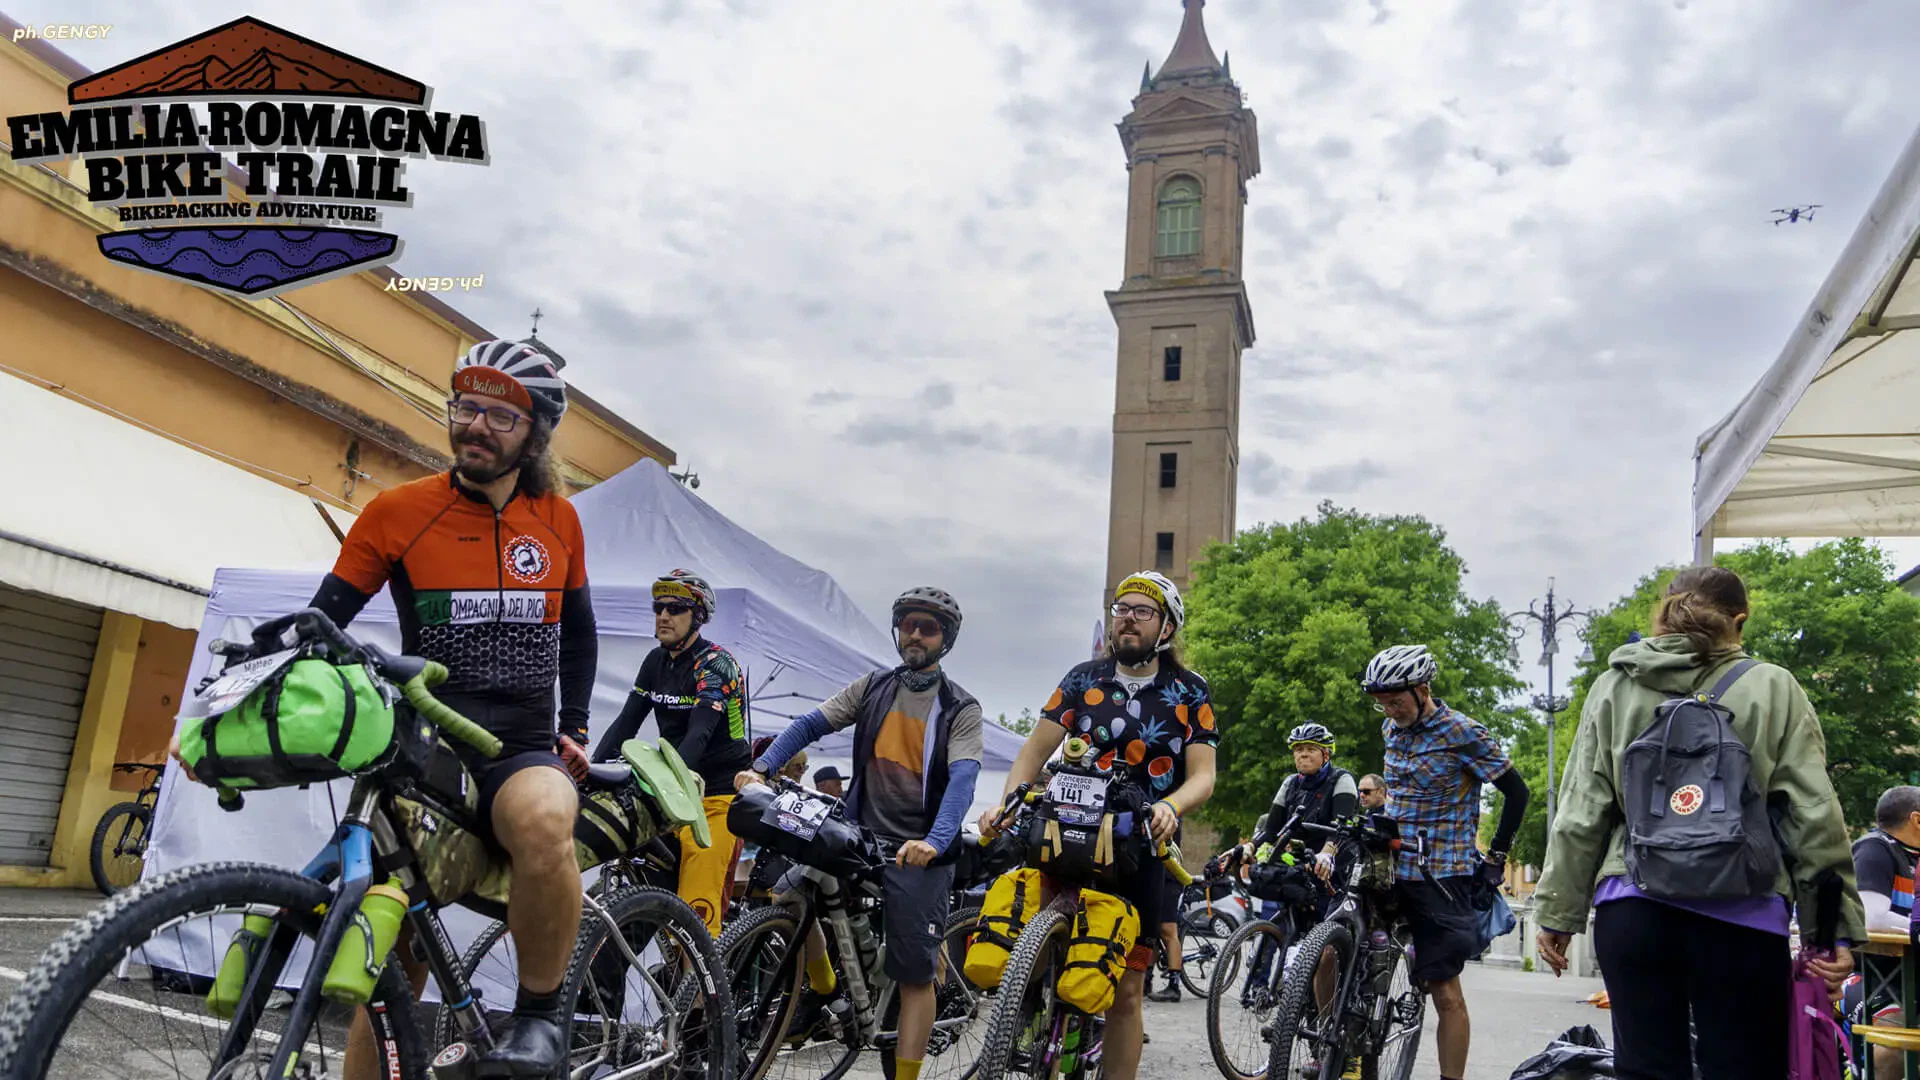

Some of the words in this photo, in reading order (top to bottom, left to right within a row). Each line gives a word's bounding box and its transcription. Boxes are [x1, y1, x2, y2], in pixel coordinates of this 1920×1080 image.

[443, 598, 505, 620] COMPAGNIA
[507, 597, 525, 619] DEL
[1061, 787, 1083, 803] 141
[788, 800, 804, 815] 18
[837, 917, 870, 1001] FOCU
[384, 1039, 402, 1080] TANS
